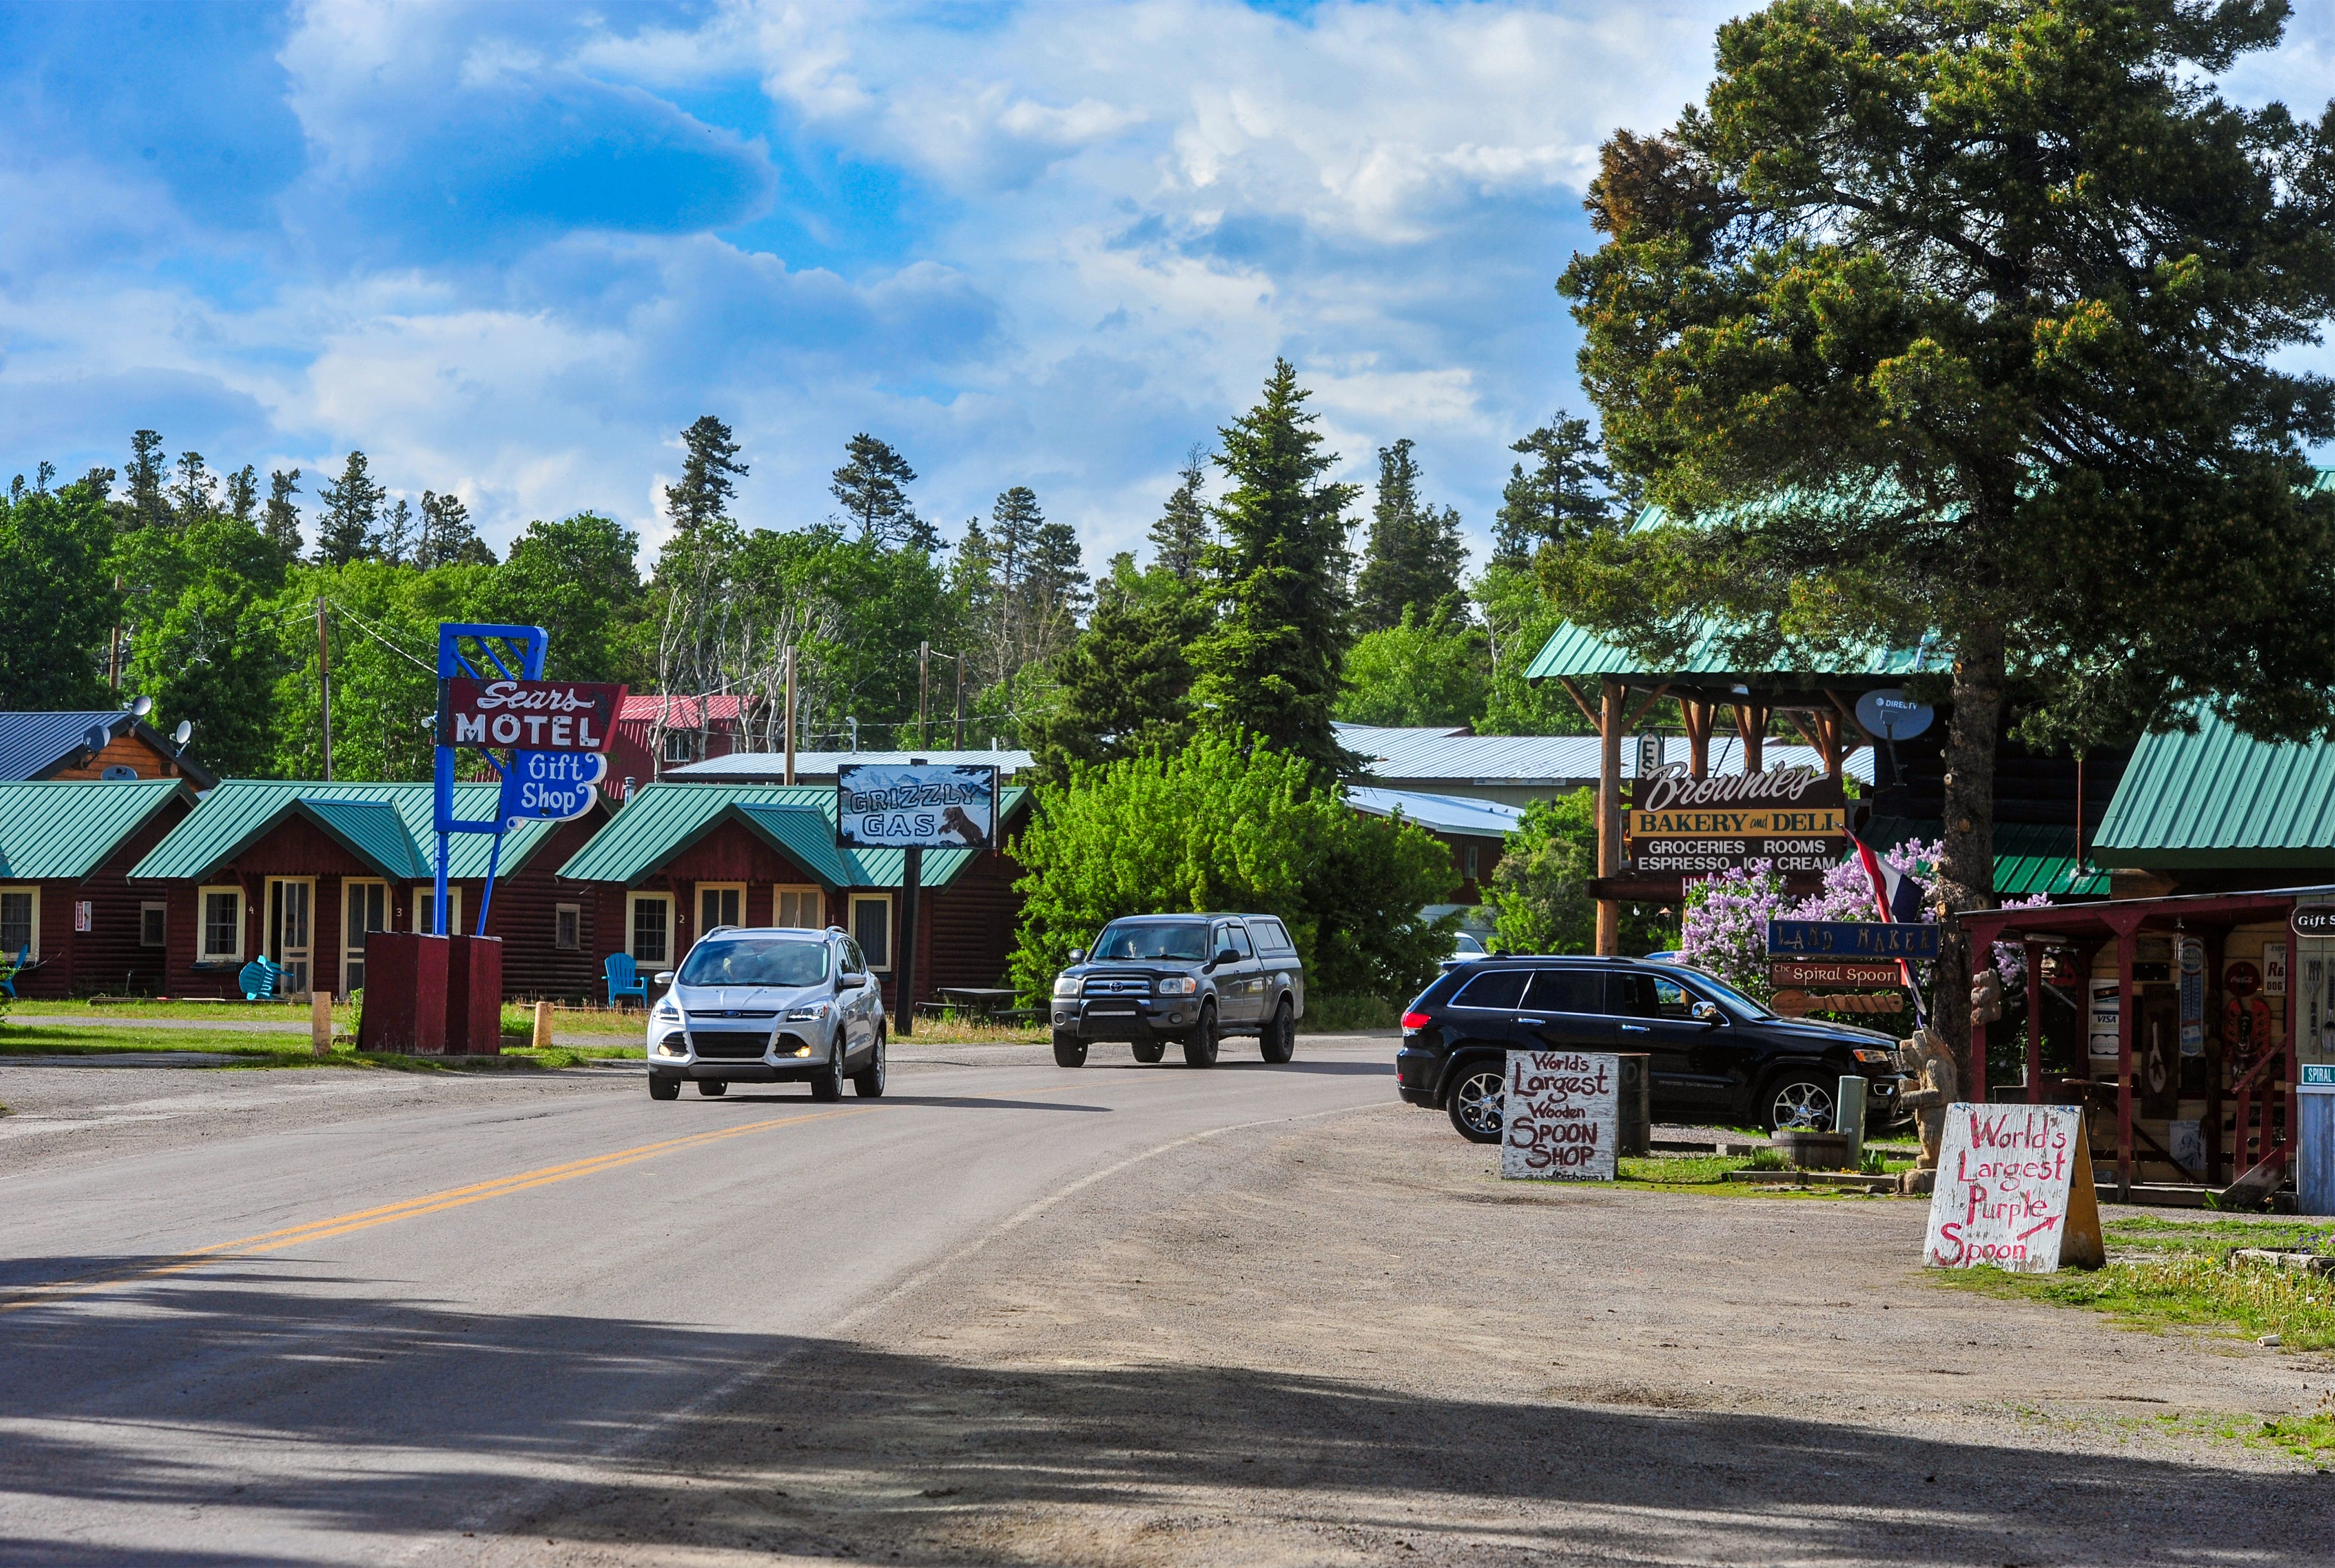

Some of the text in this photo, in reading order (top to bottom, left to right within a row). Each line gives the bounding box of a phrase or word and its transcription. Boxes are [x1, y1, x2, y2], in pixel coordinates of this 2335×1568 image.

[477, 681, 595, 712] Sears
[456, 713, 600, 748] MOTEL
[528, 753, 583, 780] Gift
[521, 782, 576, 815] Shop
[850, 783, 980, 814] GRIZZLY
[1645, 760, 1830, 813] Brownies
[862, 813, 935, 837] GAS
[1639, 813, 1834, 832] BAKERY and DELI
[1648, 840, 1826, 854] GROCERIES ROOMS
[1638, 857, 1730, 870] ESPRESSO
[1777, 857, 1836, 870] CREAM
[249, 905, 254, 914] 4
[396, 907, 403, 917] 3
[679, 915, 685, 924] 2
[2298, 915, 2326, 928] Gift
[1777, 925, 1931, 952] LAND MAKER
[1774, 964, 1790, 973] The
[1846, 968, 1896, 987] Spoon
[2097, 1015, 2117, 1023] VISA
[1531, 1052, 1589, 1072] World's
[1513, 1062, 1609, 1103] Largest
[2308, 1067, 2332, 1082] SPIRAL
[1528, 1101, 1586, 1118] Wooden
[1509, 1117, 1598, 1149] SPOON
[1970, 1111, 2066, 1149] World's
[1525, 1144, 1595, 1168] SHOP
[1959, 1149, 2066, 1192] Largest
[1966, 1184, 2048, 1229] Purple
[1934, 1222, 2026, 1268] Spoon
